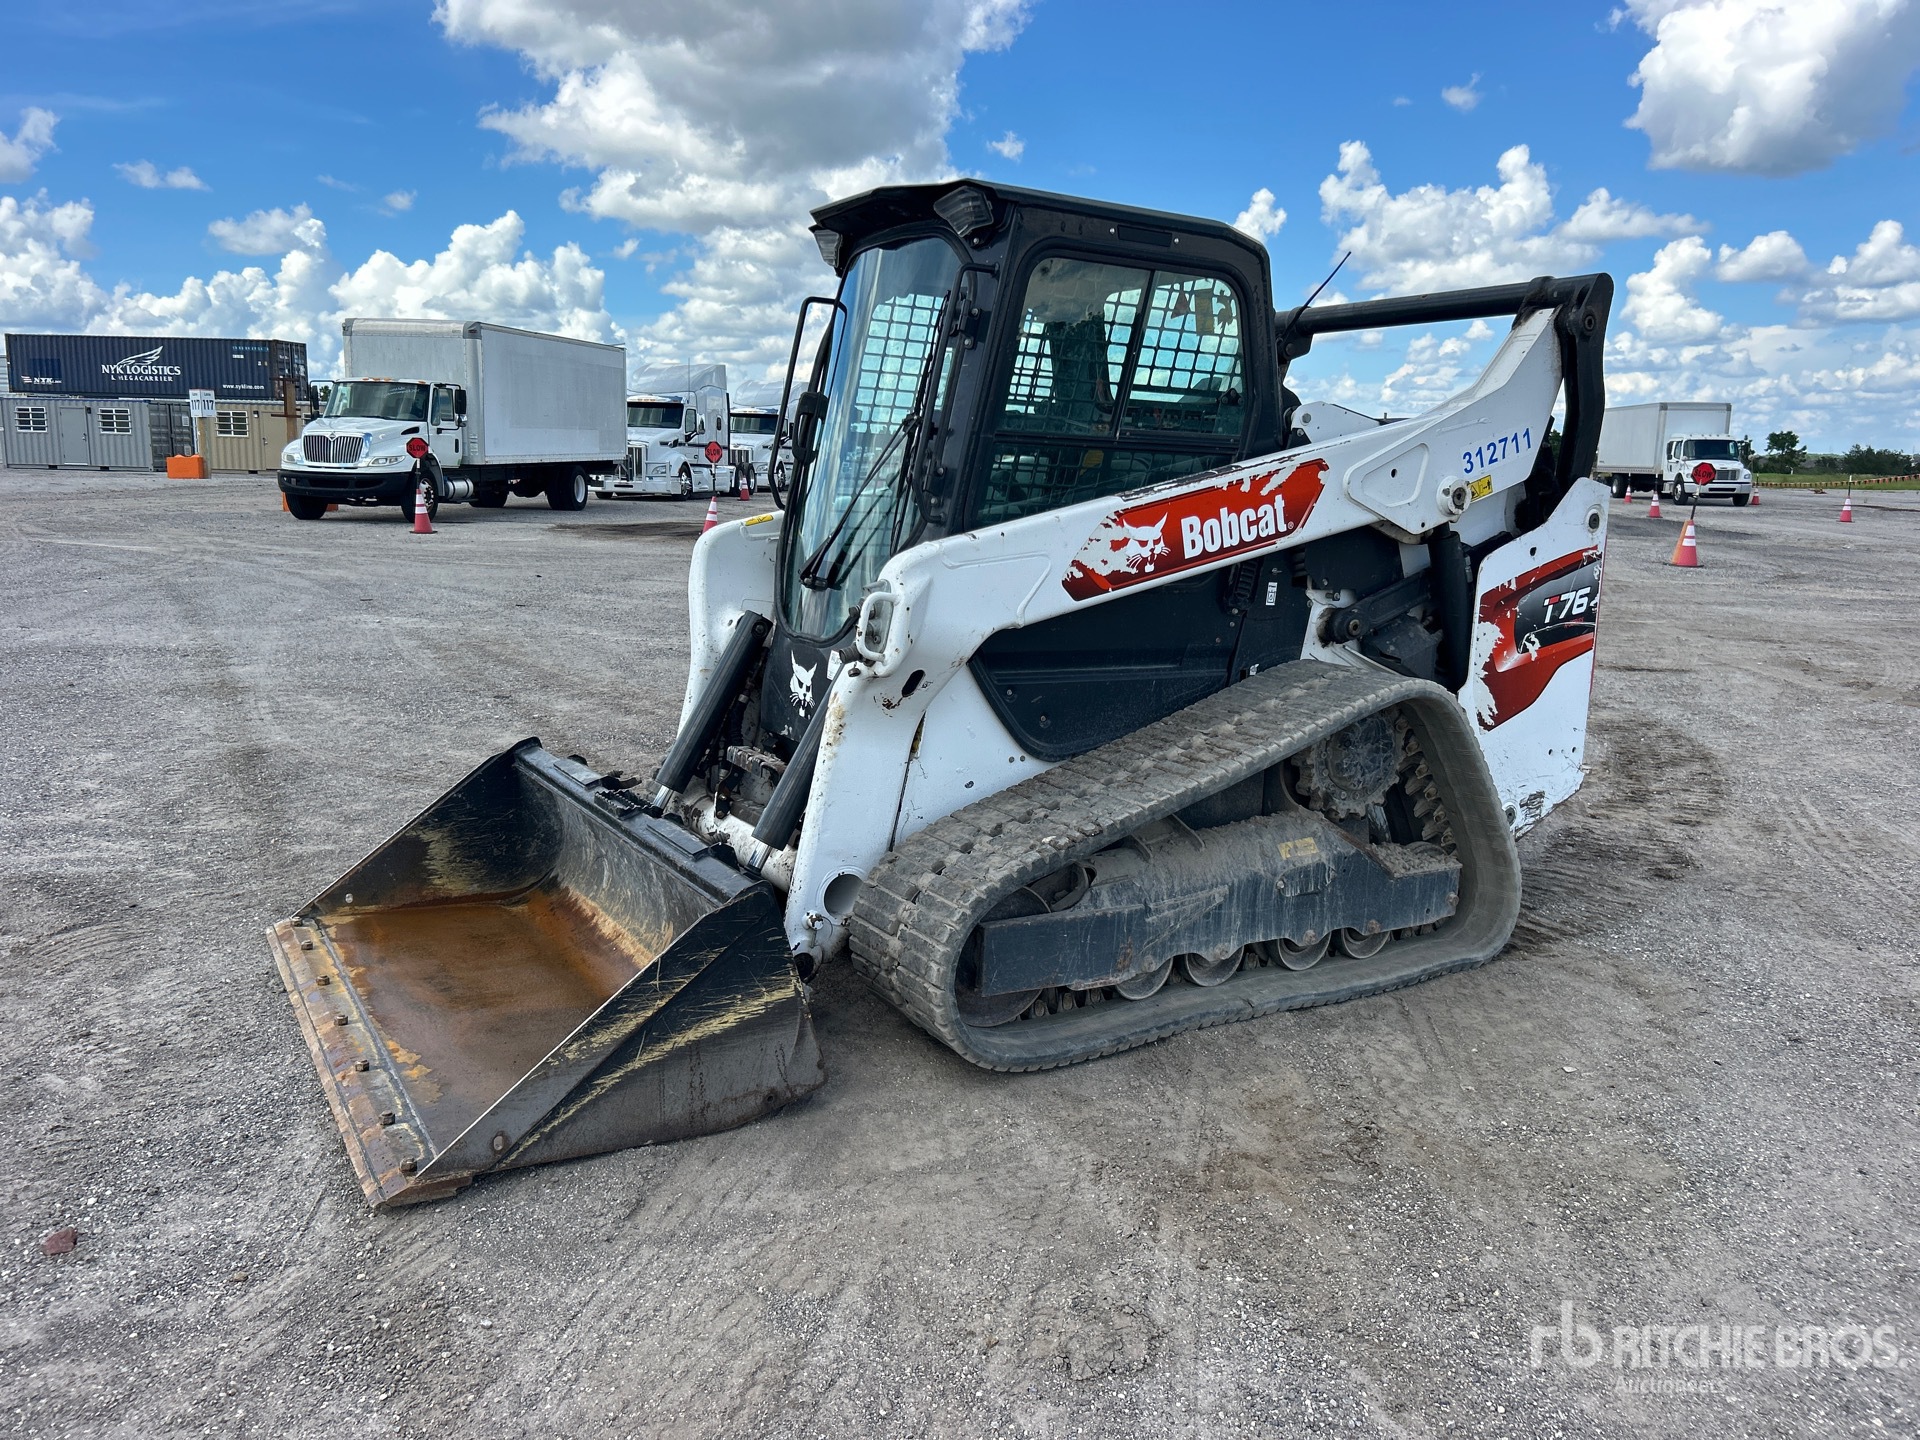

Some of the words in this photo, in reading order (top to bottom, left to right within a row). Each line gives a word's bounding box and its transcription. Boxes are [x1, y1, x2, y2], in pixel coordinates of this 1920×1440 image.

[101, 364, 124, 374] NYK
[126, 365, 181, 376] LOGISTICS
[191, 399, 200, 410] 117
[202, 399, 214, 411] 117
[408, 442, 426, 451] SLOW
[706, 448, 721, 456] SLOW
[1462, 427, 1532, 474] 312711
[1693, 469, 1713, 479] SLOW
[1181, 493, 1287, 560] Bobcat
[1543, 586, 1591, 624] T76
